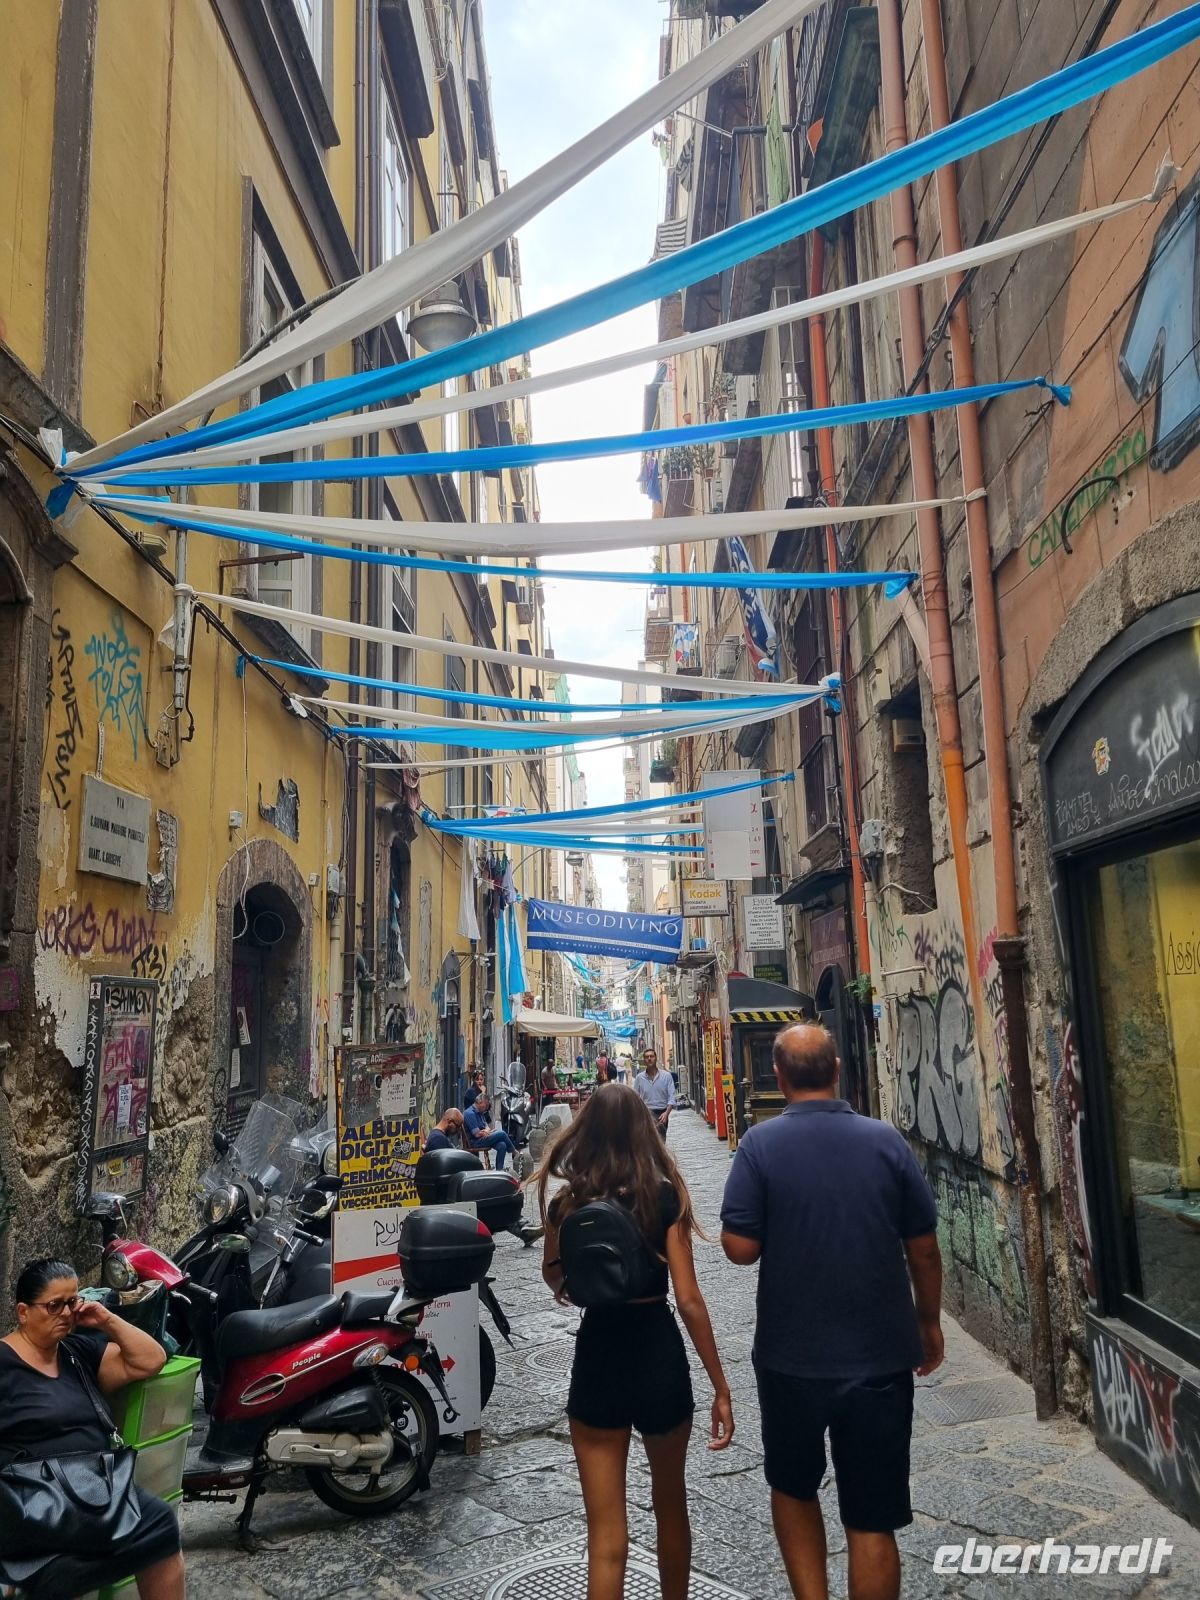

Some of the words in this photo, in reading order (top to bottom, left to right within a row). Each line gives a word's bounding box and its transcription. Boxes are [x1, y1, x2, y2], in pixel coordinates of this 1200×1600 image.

[689, 889, 721, 899] Kodak
[532, 907, 679, 936] MUSEODIVINO
[342, 1117, 419, 1142] ALBUM
[724, 1091, 736, 1148] Kodak
[341, 1135, 420, 1160] DIGITI
[380, 1190, 417, 1203] FILMATI
